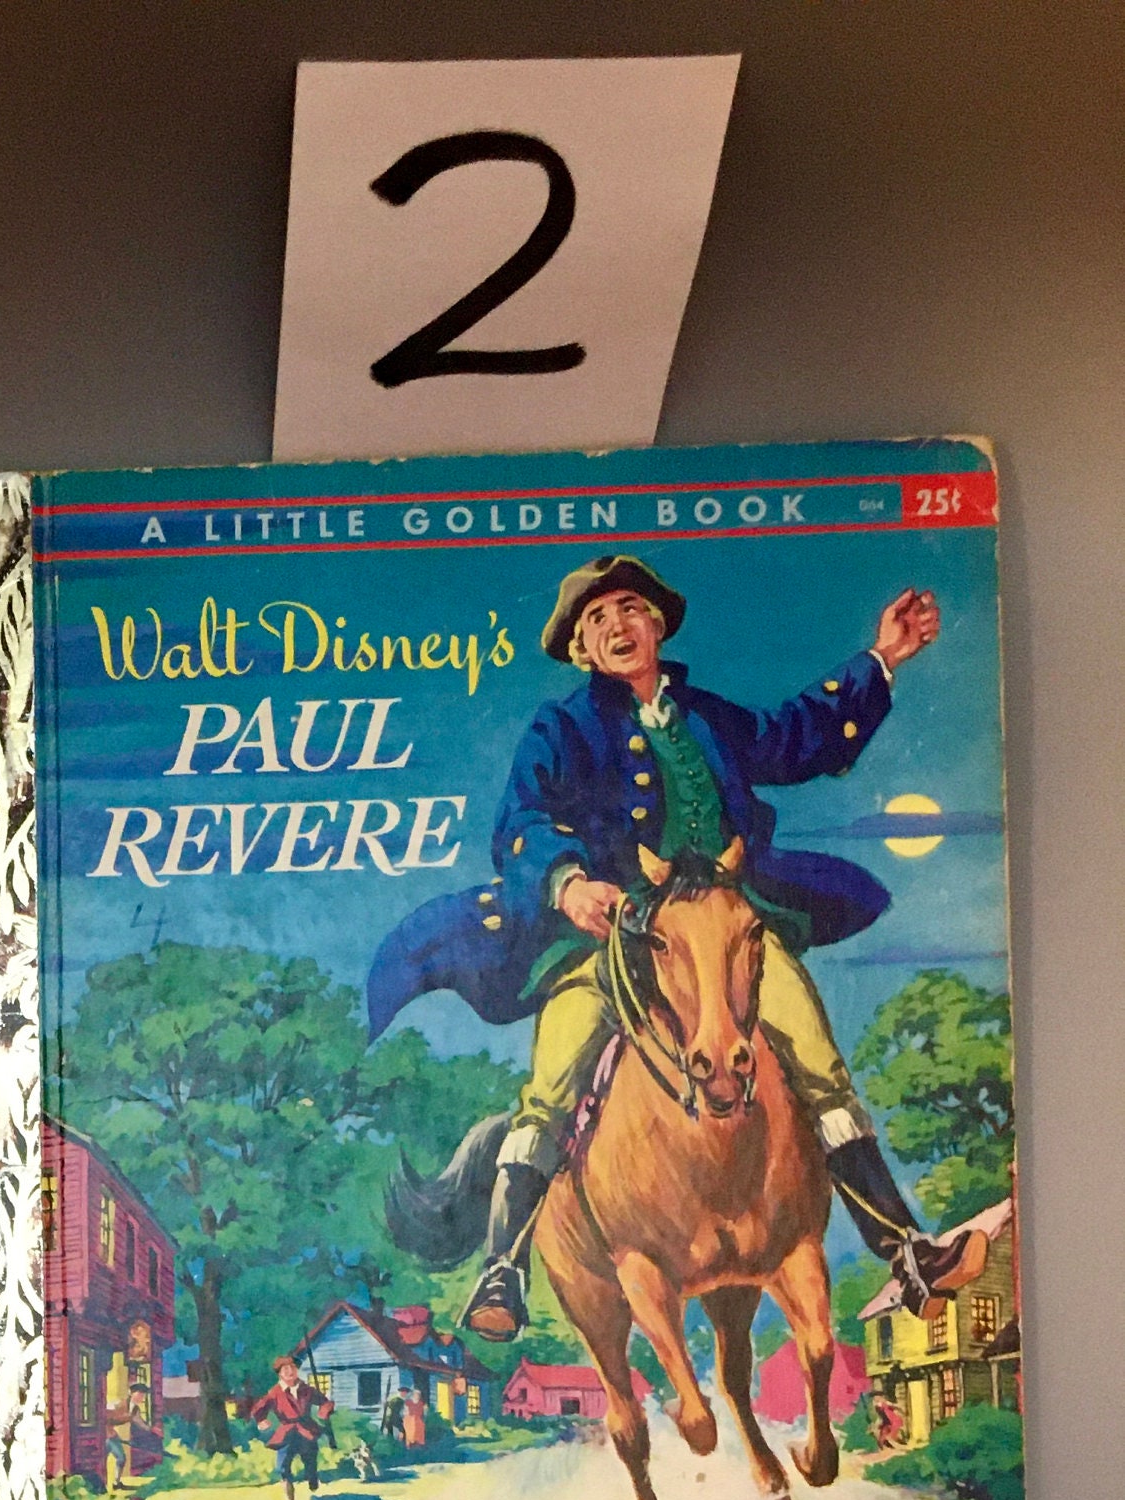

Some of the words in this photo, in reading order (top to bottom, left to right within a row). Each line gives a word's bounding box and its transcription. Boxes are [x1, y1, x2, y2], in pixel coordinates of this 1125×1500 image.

[369, 128, 587, 388] 2
[140, 516, 166, 543] A
[205, 509, 365, 541] LITTLE
[402, 500, 617, 536] GOLDEN
[657, 494, 805, 527] BOOK
[916, 487, 962, 516] 25¢
[91, 596, 255, 681] Walt
[258, 600, 516, 696] Disney's
[163, 696, 414, 776] PAUL
[85, 795, 468, 888] REVERE
